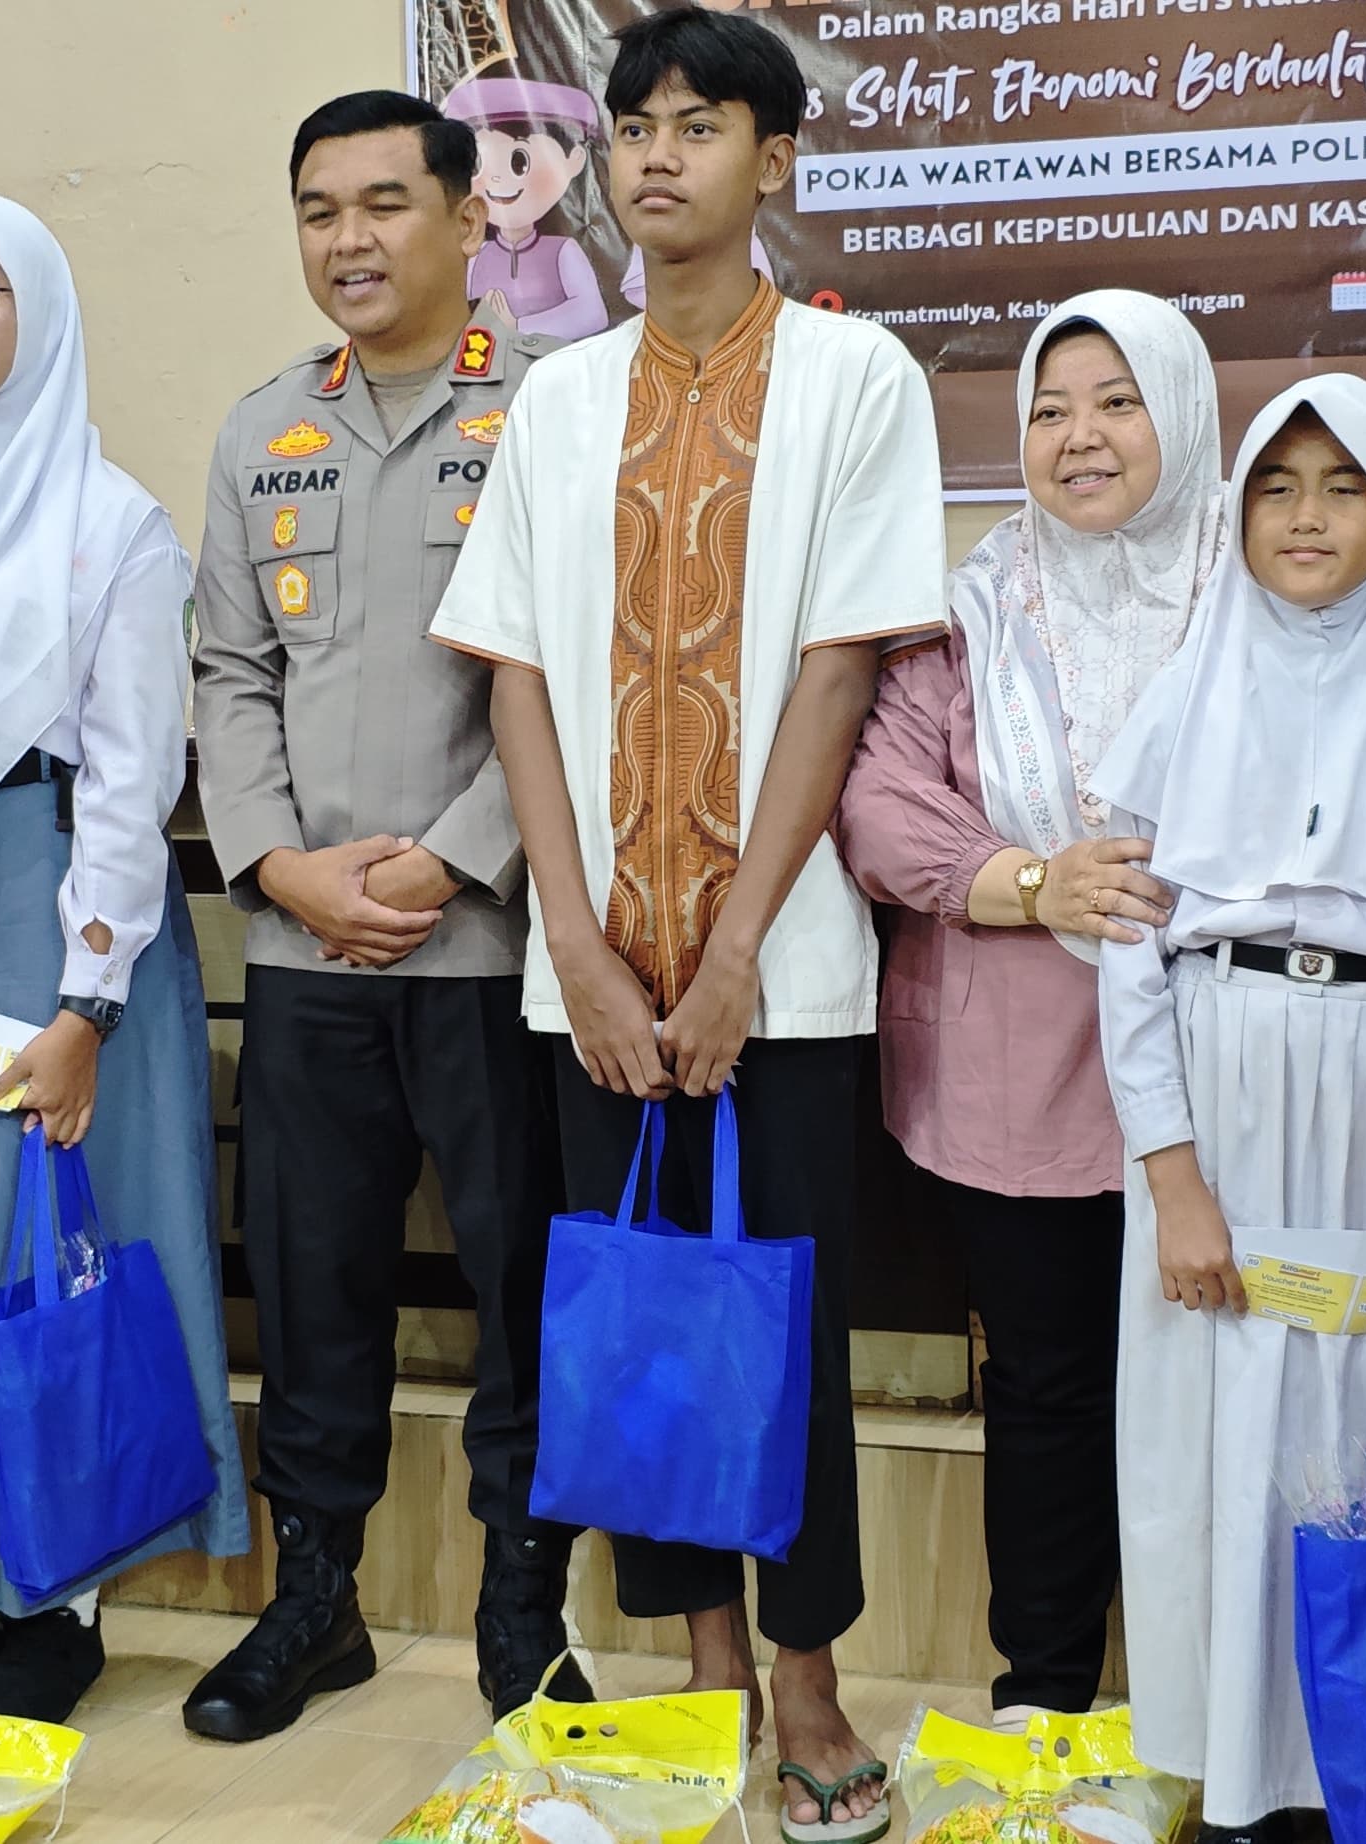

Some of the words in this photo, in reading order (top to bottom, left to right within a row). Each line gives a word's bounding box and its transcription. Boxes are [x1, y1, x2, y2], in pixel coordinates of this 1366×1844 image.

[818, 11, 925, 41] Dalam
[936, 0, 1062, 35] Rangka
[1072, 0, 1145, 23] Hari
[845, 57, 976, 128] Sehat,
[991, 55, 1160, 123] Ekonomi
[807, 165, 909, 193] POKJA
[921, 151, 1111, 185] WARTAWAN
[1125, 142, 1278, 175] BERSAMA
[843, 222, 983, 253] BERBAGI
[994, 208, 1208, 245] KEPEDULIAN
[1220, 202, 1297, 233] DAN
[1166, 293, 1245, 315] ningan
[250, 468, 340, 497] AKBAR
[438, 459, 487, 483] PO
